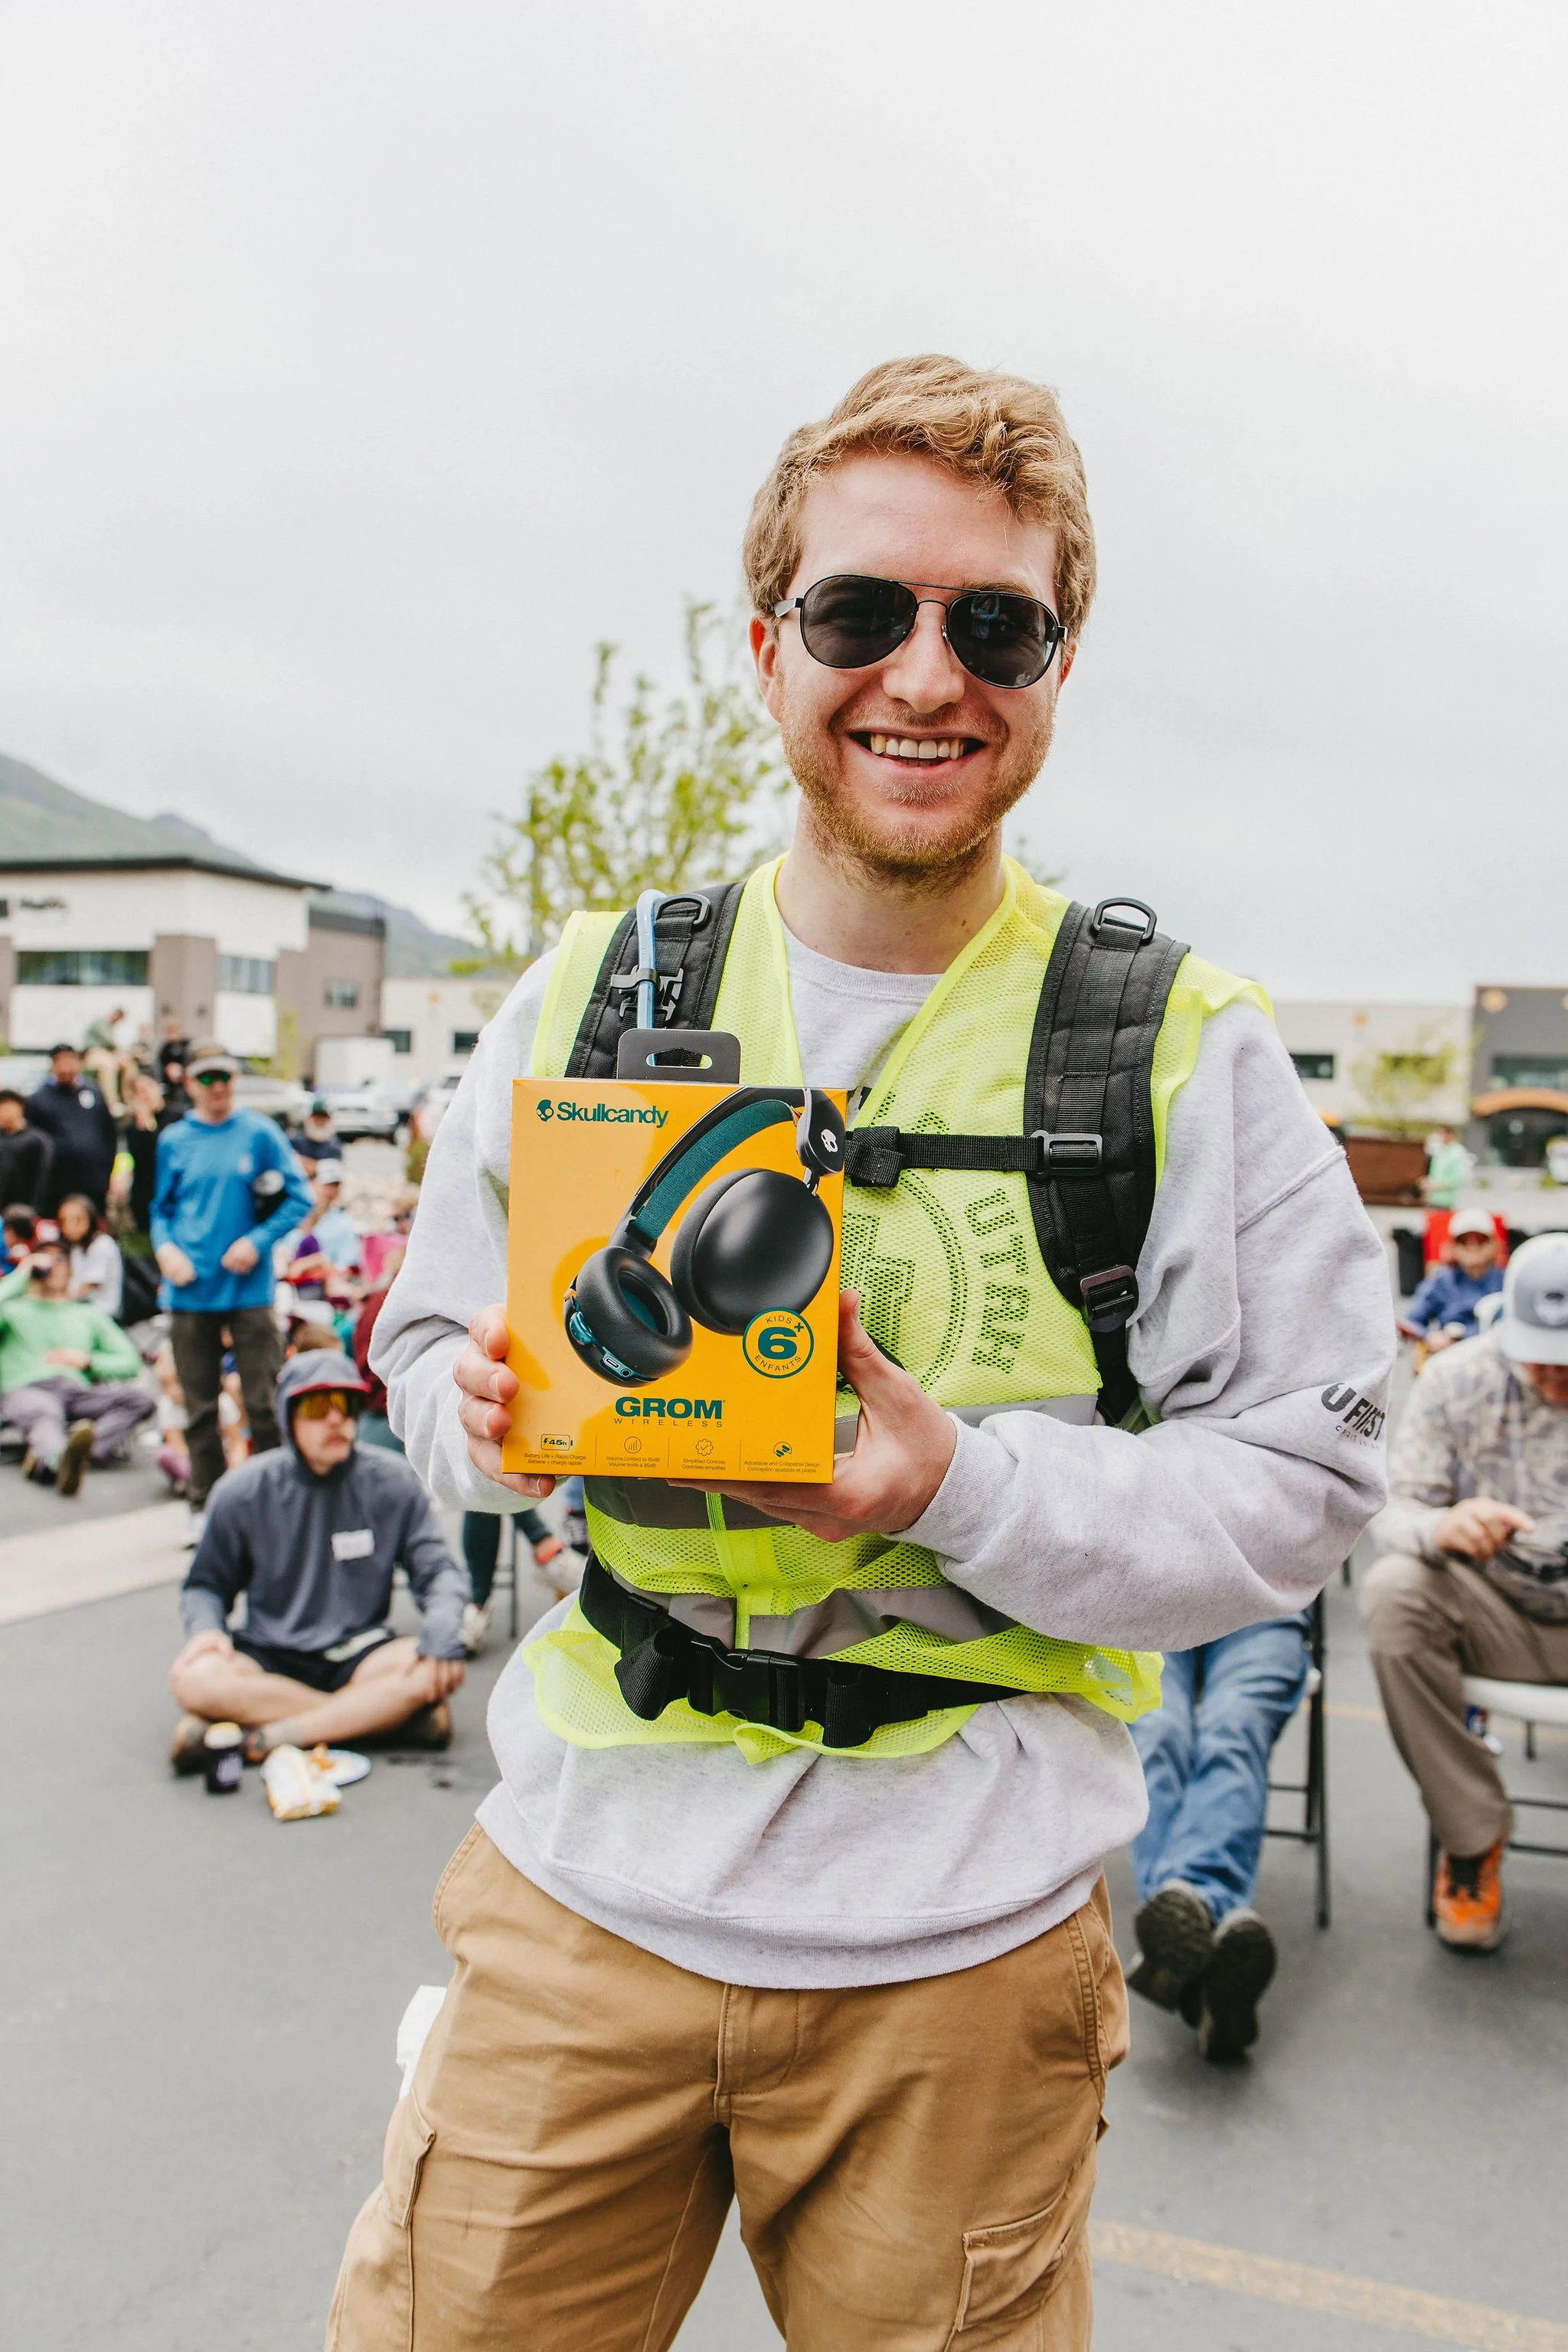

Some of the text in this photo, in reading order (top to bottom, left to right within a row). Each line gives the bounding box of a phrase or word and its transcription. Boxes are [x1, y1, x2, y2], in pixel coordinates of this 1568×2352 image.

[557, 1102, 668, 1128] Skullcandy
[766, 1315, 792, 1324] KIDS
[754, 1354, 802, 1372] ENFANTS
[615, 1396, 722, 1419] GROM
[613, 1418, 723, 1428] WIRELESS
